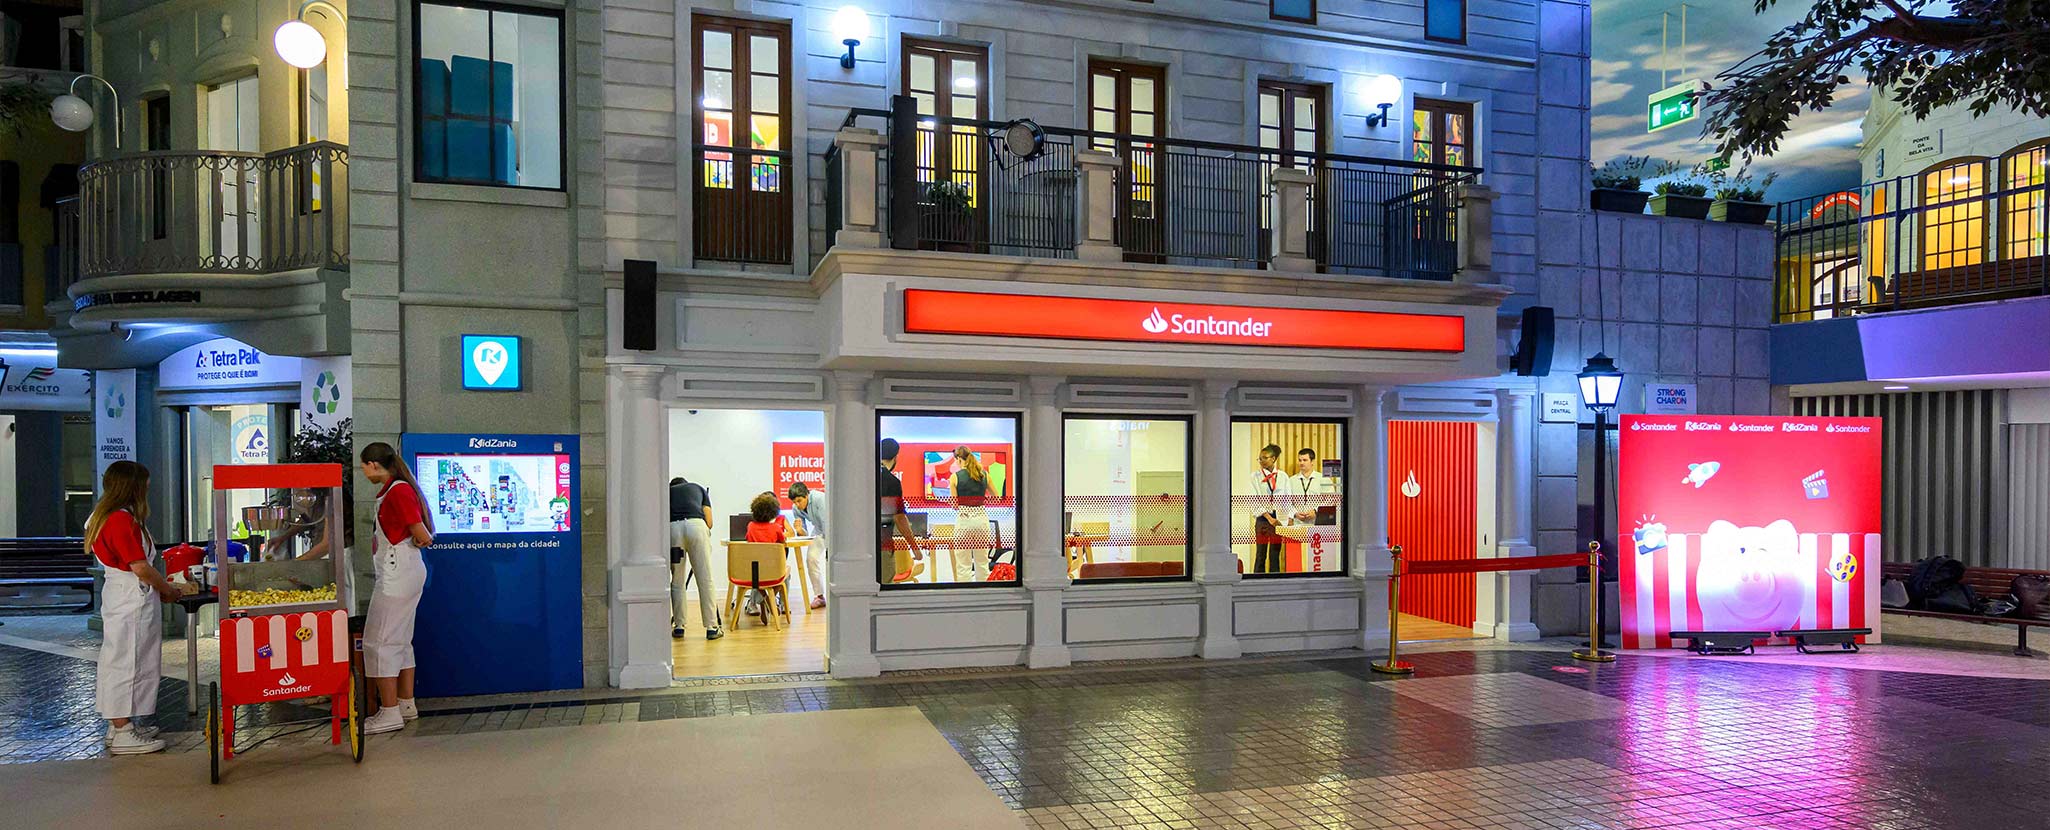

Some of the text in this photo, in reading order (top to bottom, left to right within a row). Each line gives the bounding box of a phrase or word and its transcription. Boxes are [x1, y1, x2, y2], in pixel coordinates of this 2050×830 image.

[1171, 314, 1272, 337] Santander
[210, 348, 260, 366] Tetra Pak
[1657, 388, 1686, 397] STRONG
[1656, 396, 1687, 404] CHARON
[1641, 423, 1677, 431] Santander
[1738, 423, 1774, 432] Santander
[469, 438, 517, 448] KidZania
[780, 456, 788, 468] A
[780, 472, 792, 482] se
[466, 540, 484, 550] aqui
[518, 540, 529, 548] da
[530, 538, 560, 547] cidade!
[263, 685, 311, 697] Santander
